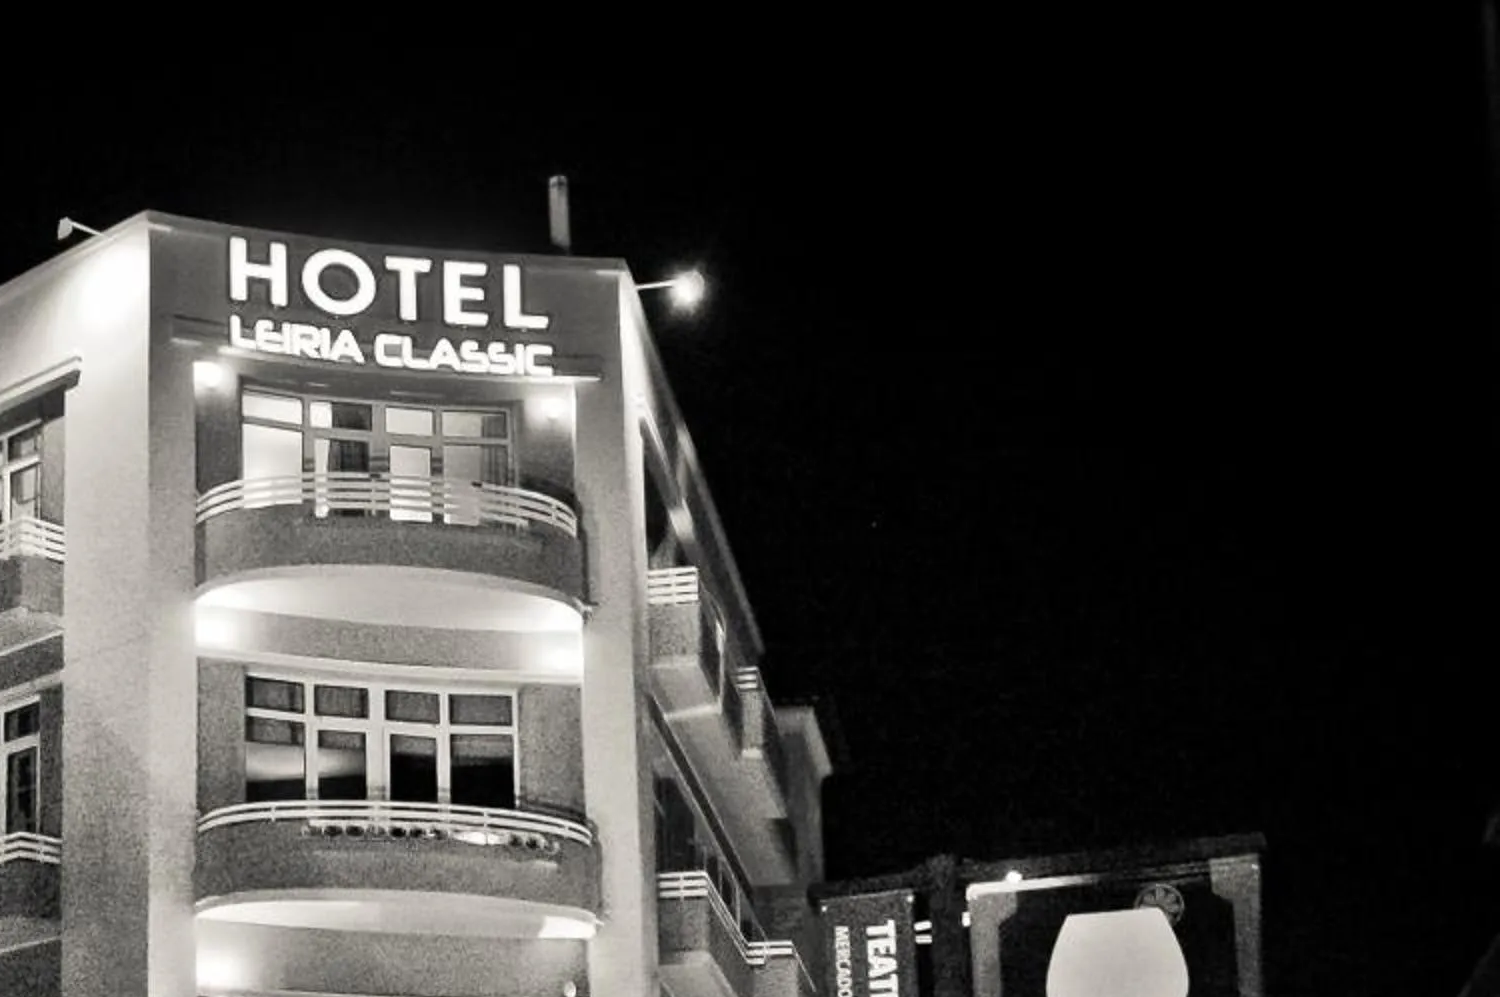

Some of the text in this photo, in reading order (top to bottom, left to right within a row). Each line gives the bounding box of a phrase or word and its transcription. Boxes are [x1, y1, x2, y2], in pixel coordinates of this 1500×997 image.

[229, 236, 549, 329] HOTEL
[230, 314, 554, 376] LEIRIA CLASSIC
